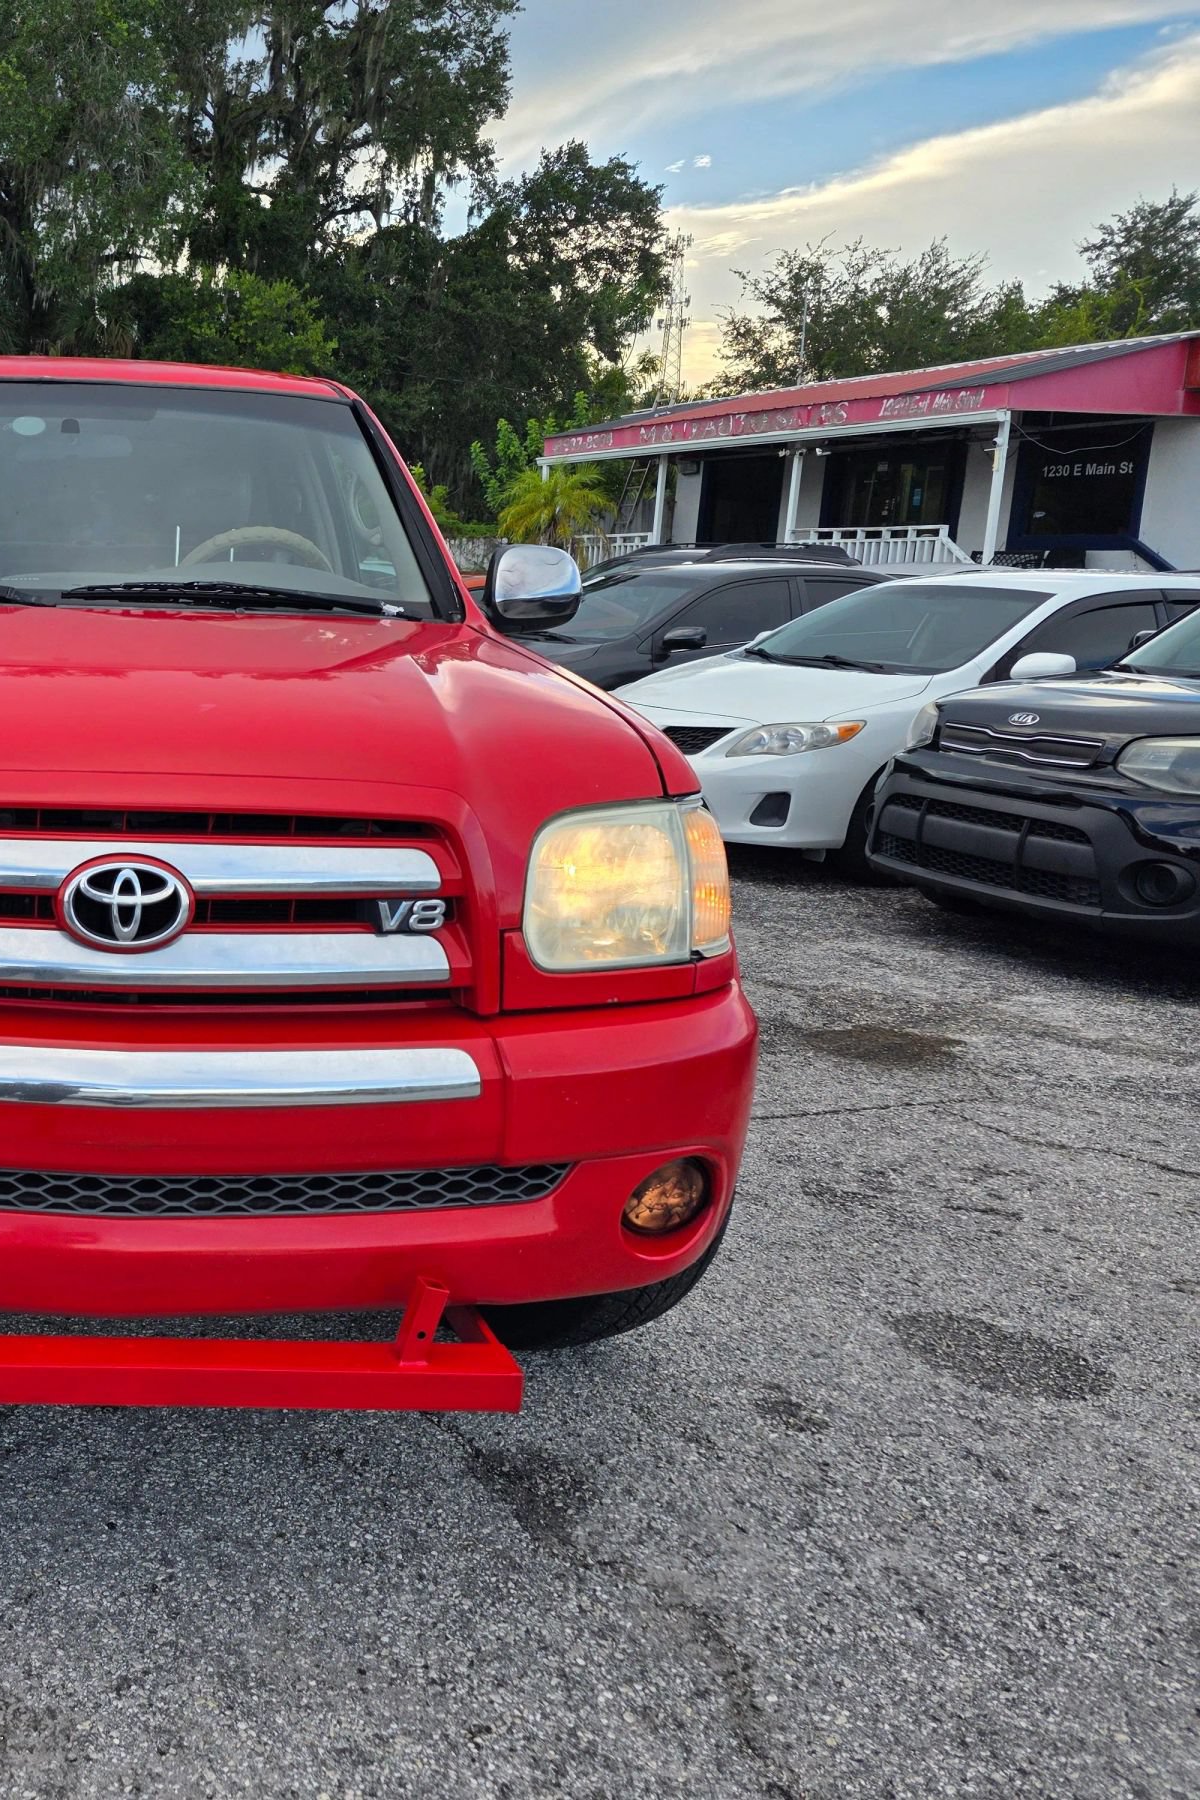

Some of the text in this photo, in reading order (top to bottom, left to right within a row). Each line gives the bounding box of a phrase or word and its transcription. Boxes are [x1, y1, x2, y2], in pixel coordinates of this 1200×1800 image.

[1042, 461, 1134, 478] 1230 E Main St
[1011, 713, 1035, 723] KIA
[377, 898, 446, 932] V8
